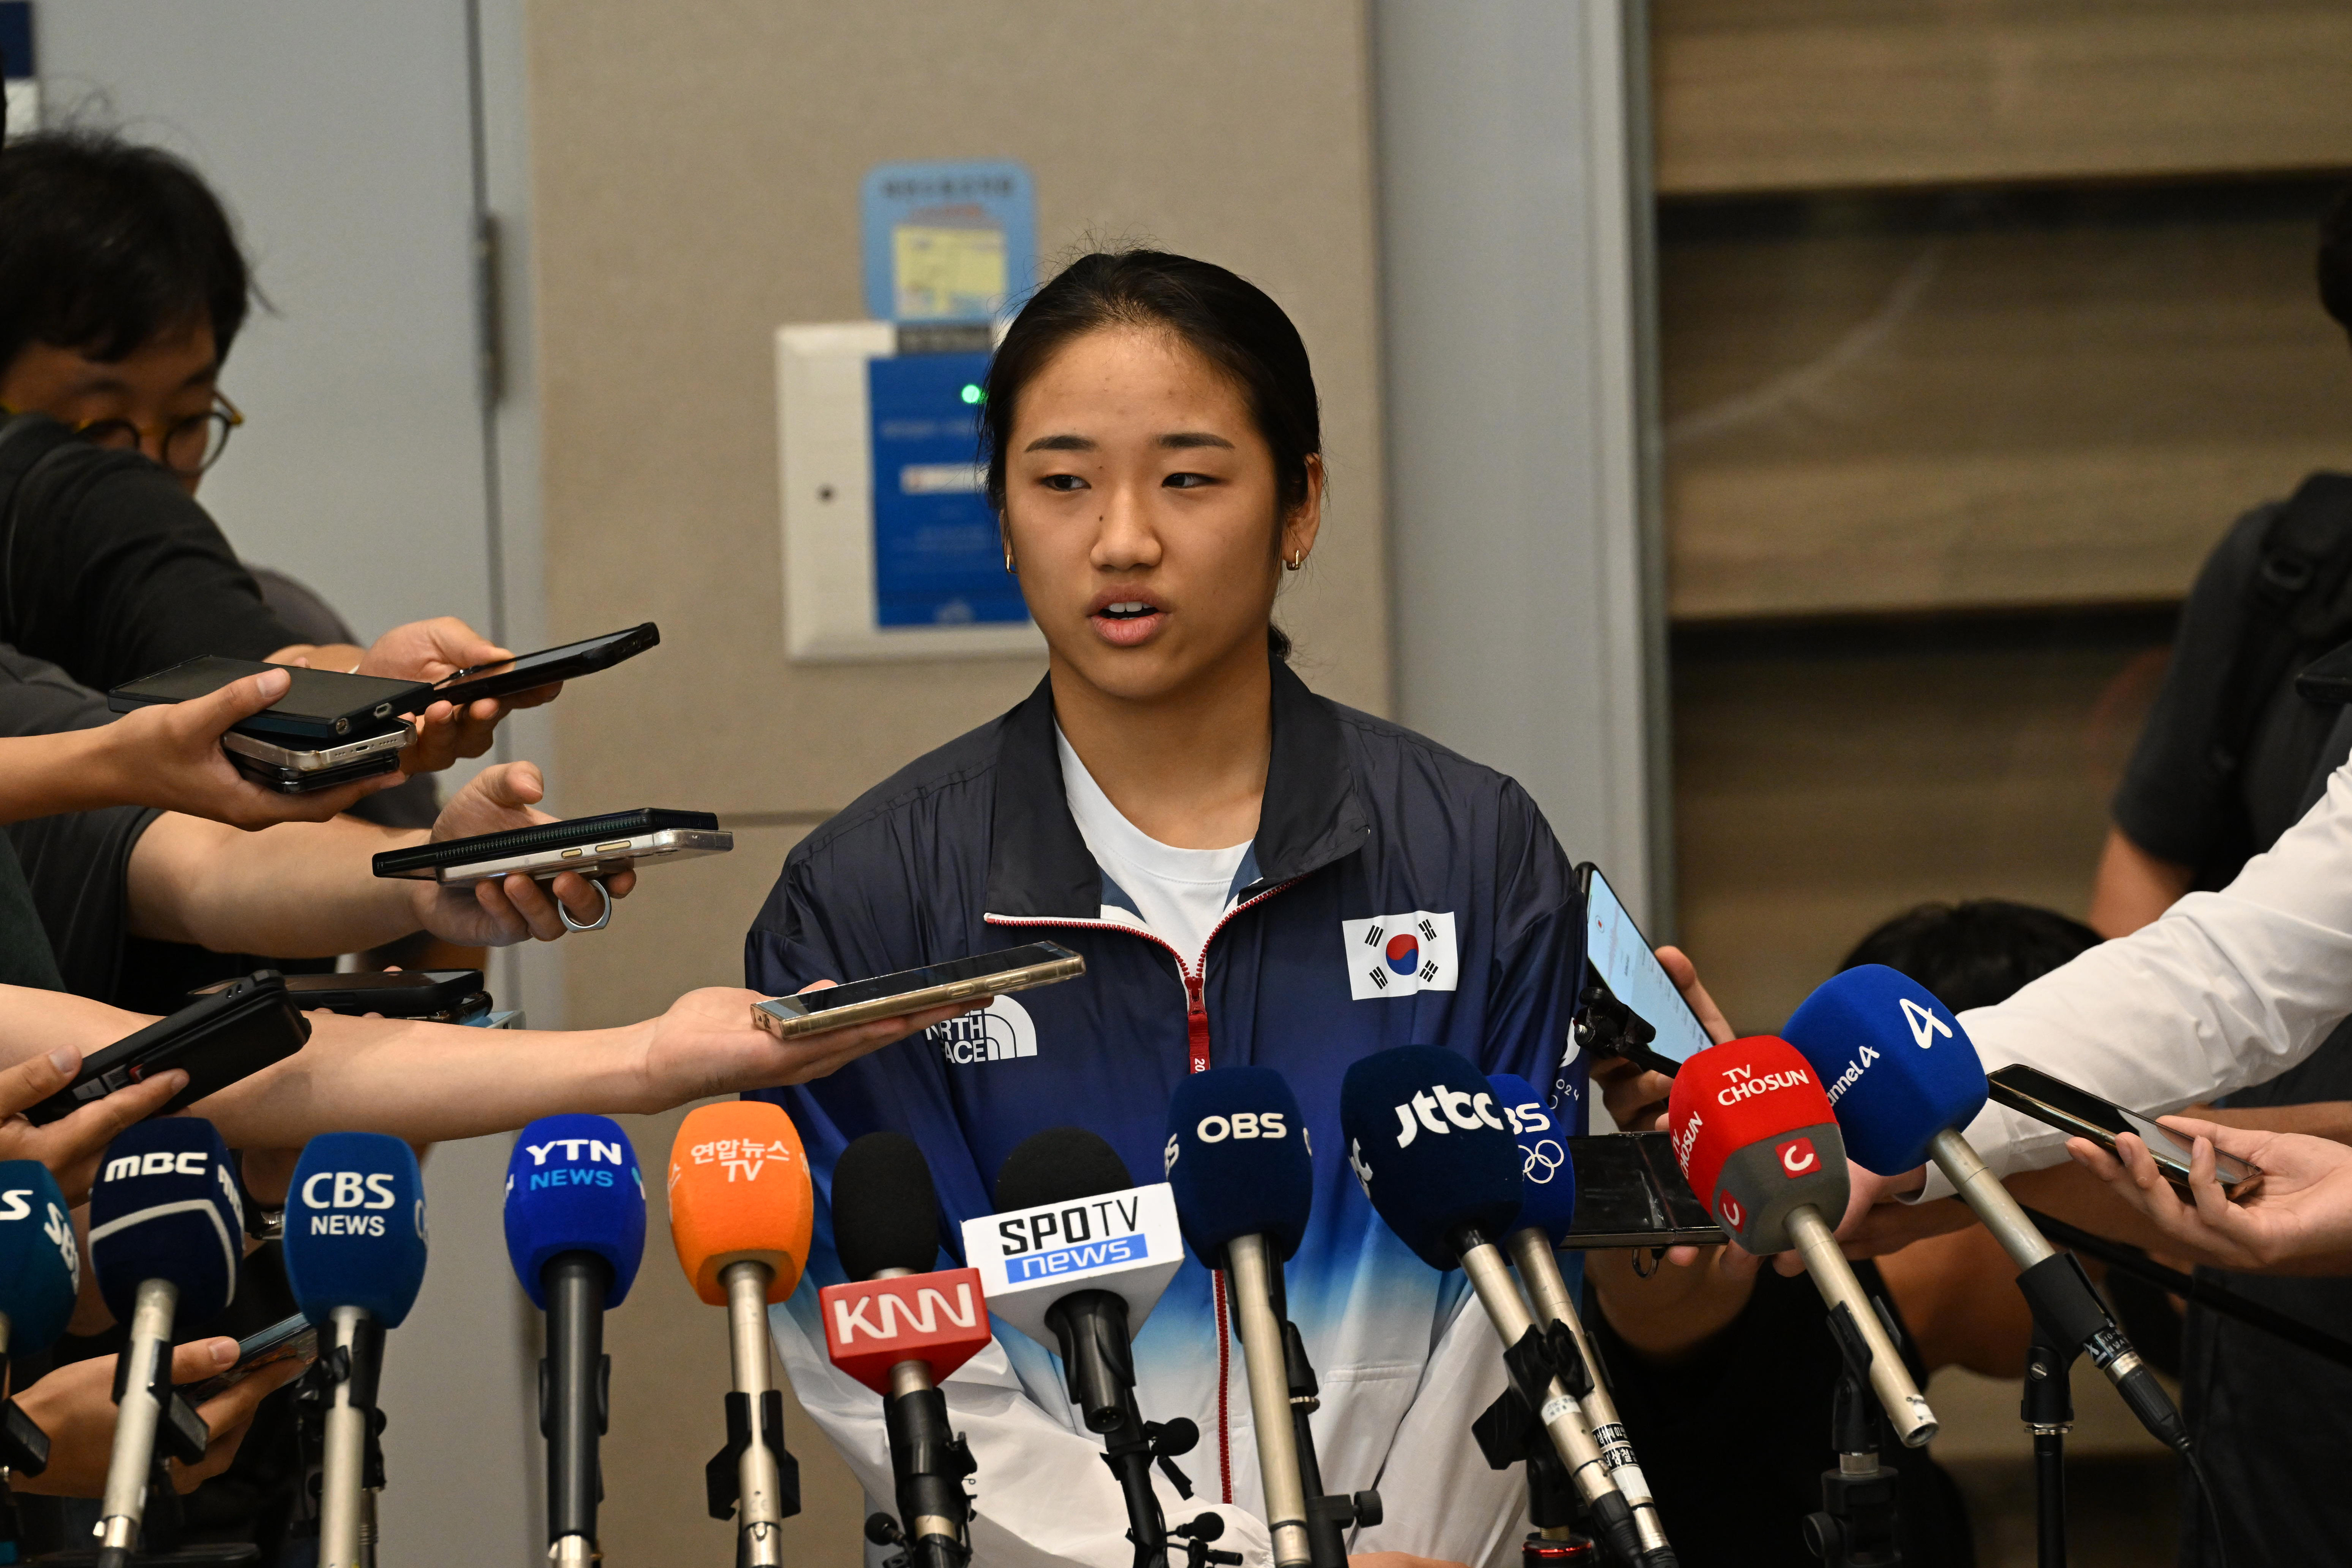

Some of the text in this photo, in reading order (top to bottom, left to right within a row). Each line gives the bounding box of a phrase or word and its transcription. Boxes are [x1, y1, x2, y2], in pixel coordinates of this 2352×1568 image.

[926, 1016, 983, 1040] NRTH
[941, 1039, 985, 1064] ACE
[1195, 1058, 1205, 1074] 20
[1722, 1064, 1750, 1083] TV
[1556, 1079, 1579, 1101] 024
[1718, 1069, 1810, 1106] CHOSUN
[1197, 1112, 1287, 1143] OBS
[1395, 1085, 1504, 1148] jtbc
[1504, 1103, 1550, 1135] BS
[526, 1139, 622, 1165] YTN
[691, 1139, 789, 1165] 연합뉴스
[104, 1152, 208, 1182] MBC
[530, 1169, 613, 1191] NEWS
[721, 1160, 763, 1182] TV
[302, 1172, 395, 1209] CBS
[311, 1215, 385, 1236] NEWS
[999, 1196, 1138, 1256] SPOTV
[1028, 1240, 1131, 1278] news
[834, 1283, 976, 1344] KNN
